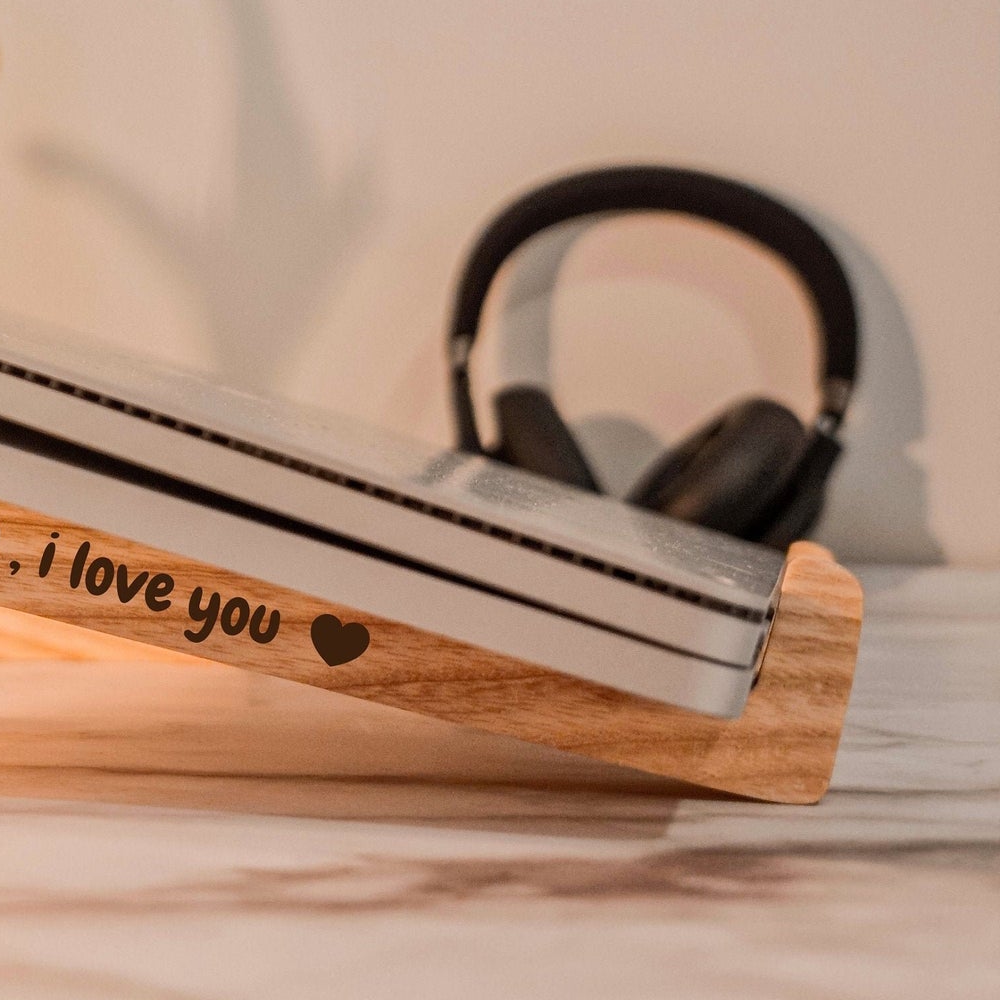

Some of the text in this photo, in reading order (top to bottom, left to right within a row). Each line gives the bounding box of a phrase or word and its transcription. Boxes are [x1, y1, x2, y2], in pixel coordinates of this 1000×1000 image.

[38, 531, 60, 578] i
[69, 541, 175, 612] love
[183, 586, 281, 644] you
